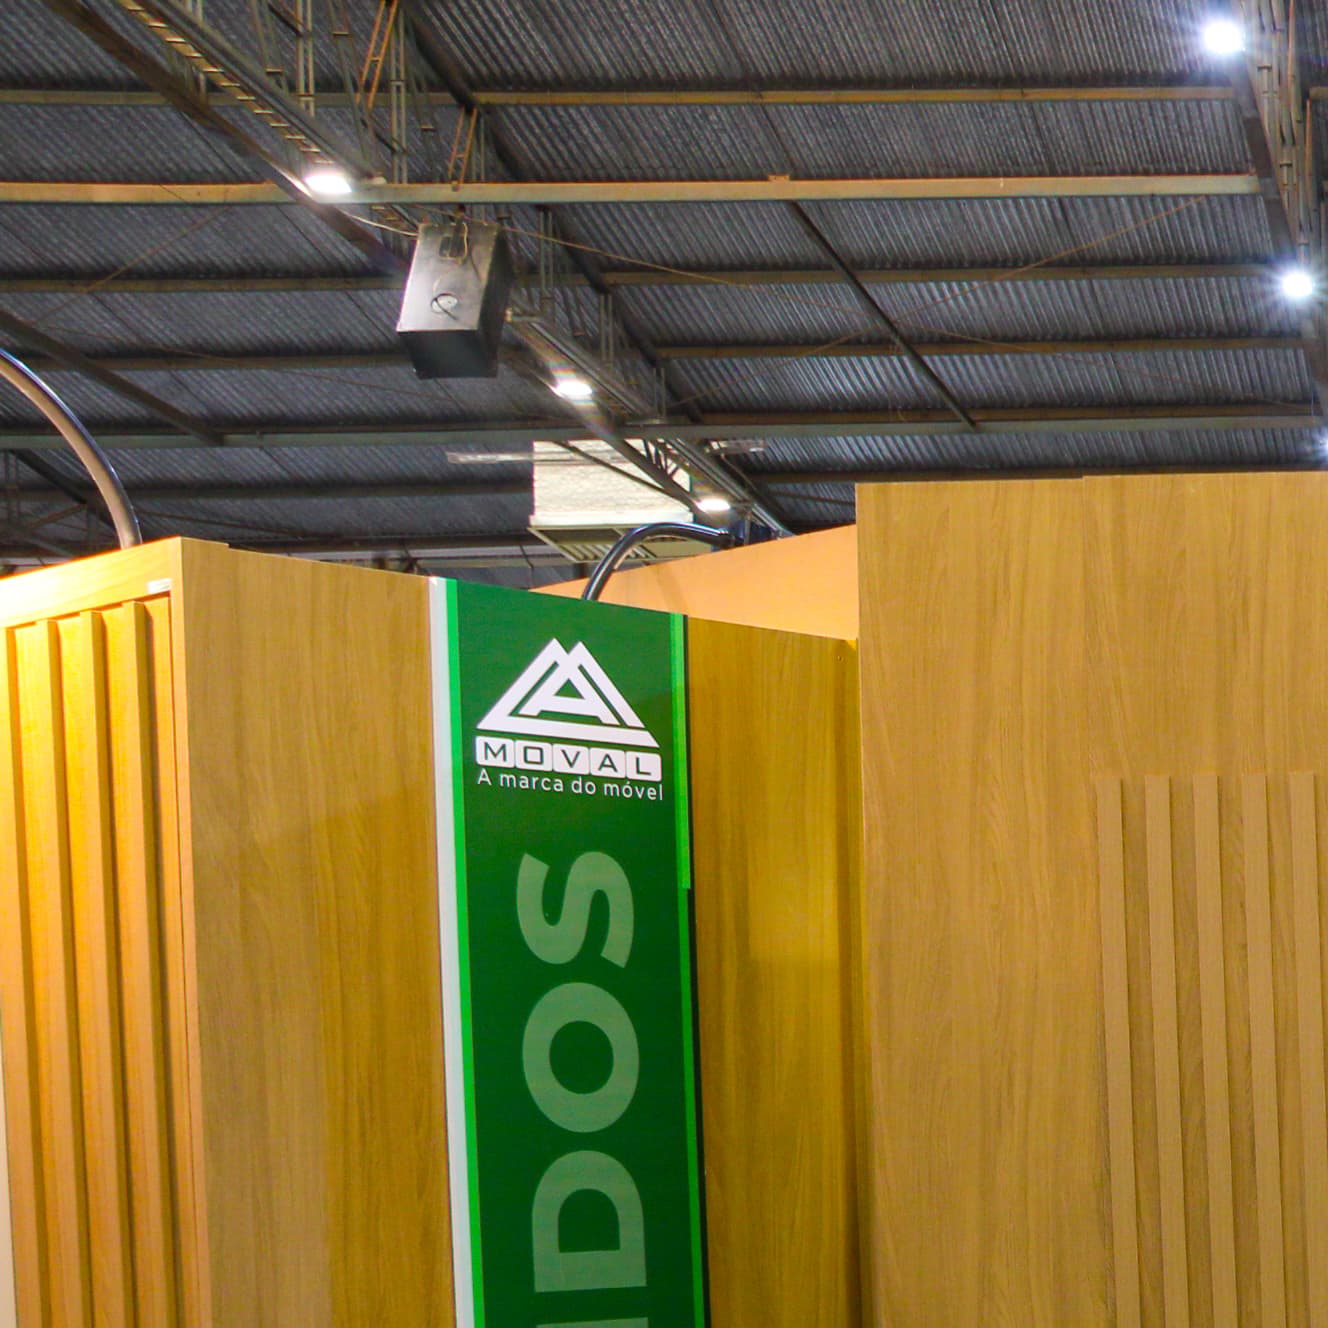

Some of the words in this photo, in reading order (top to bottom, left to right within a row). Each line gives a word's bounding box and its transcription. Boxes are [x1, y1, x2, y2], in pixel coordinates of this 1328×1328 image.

[482, 740, 654, 778] MOVAL
[477, 768, 492, 786] A
[500, 773, 564, 792] marca
[571, 776, 596, 795] do
[604, 780, 663, 801] móvel
